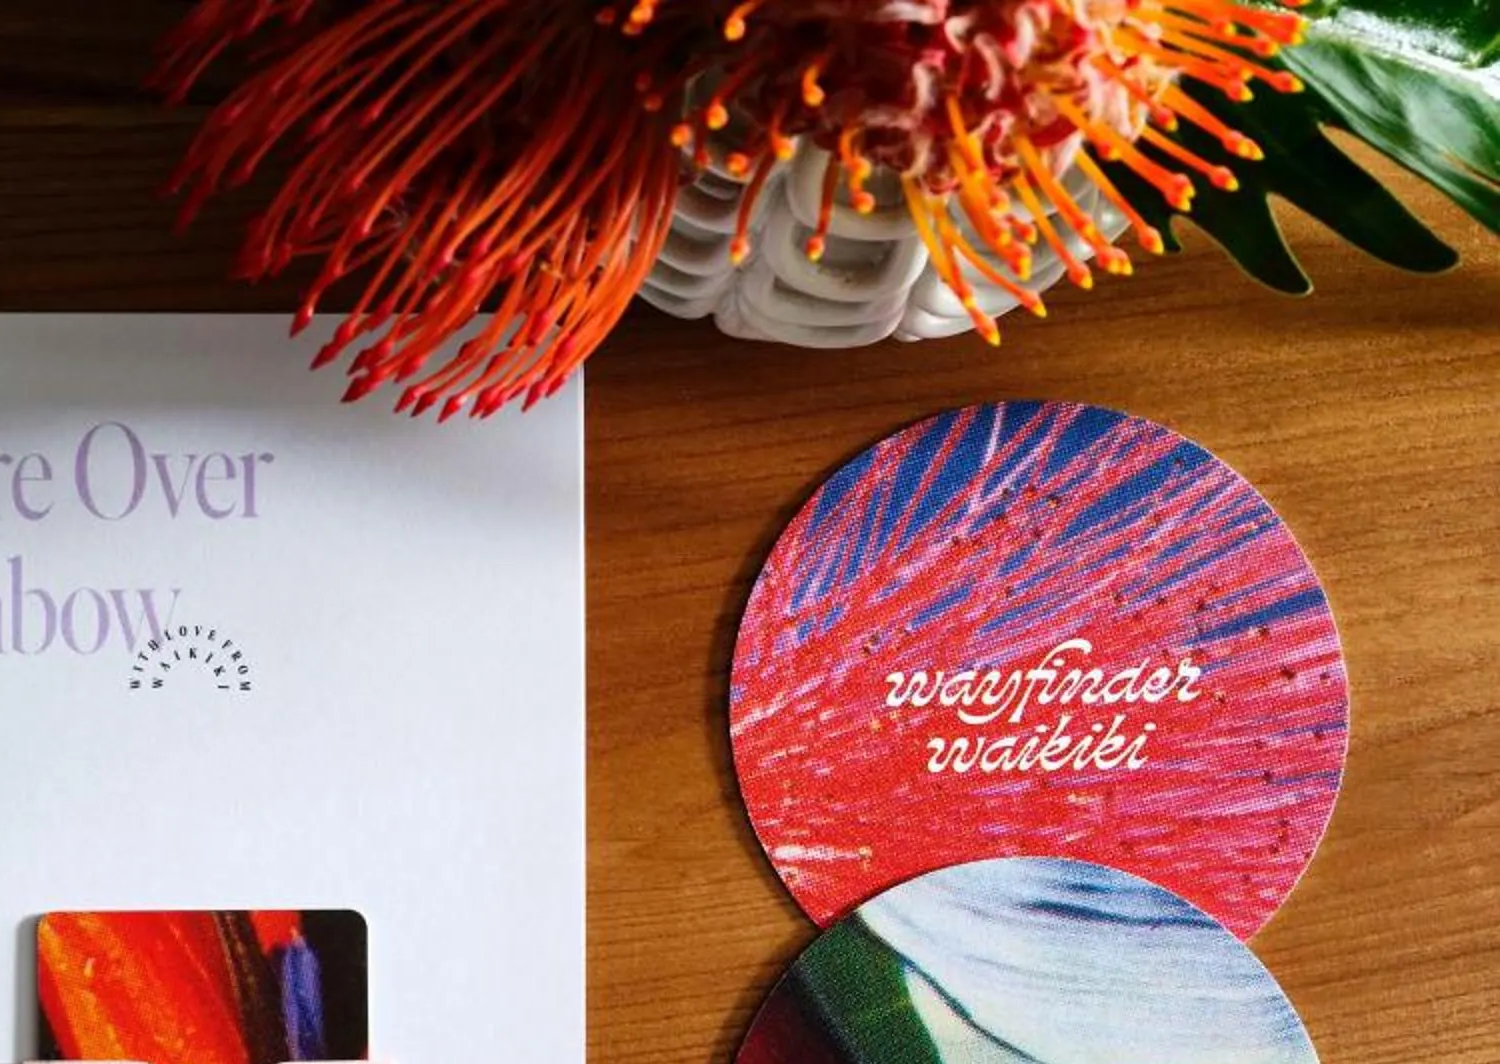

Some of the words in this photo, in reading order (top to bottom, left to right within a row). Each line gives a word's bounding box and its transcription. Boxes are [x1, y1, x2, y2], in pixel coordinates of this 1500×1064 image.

[75, 421, 275, 522] Over
[152, 647, 230, 690] WAIKIKI
[164, 625, 216, 642] LOVE
[221, 639, 252, 691] FROM
[885, 637, 1202, 724] wayfinder
[926, 714, 1157, 773] waikiki
